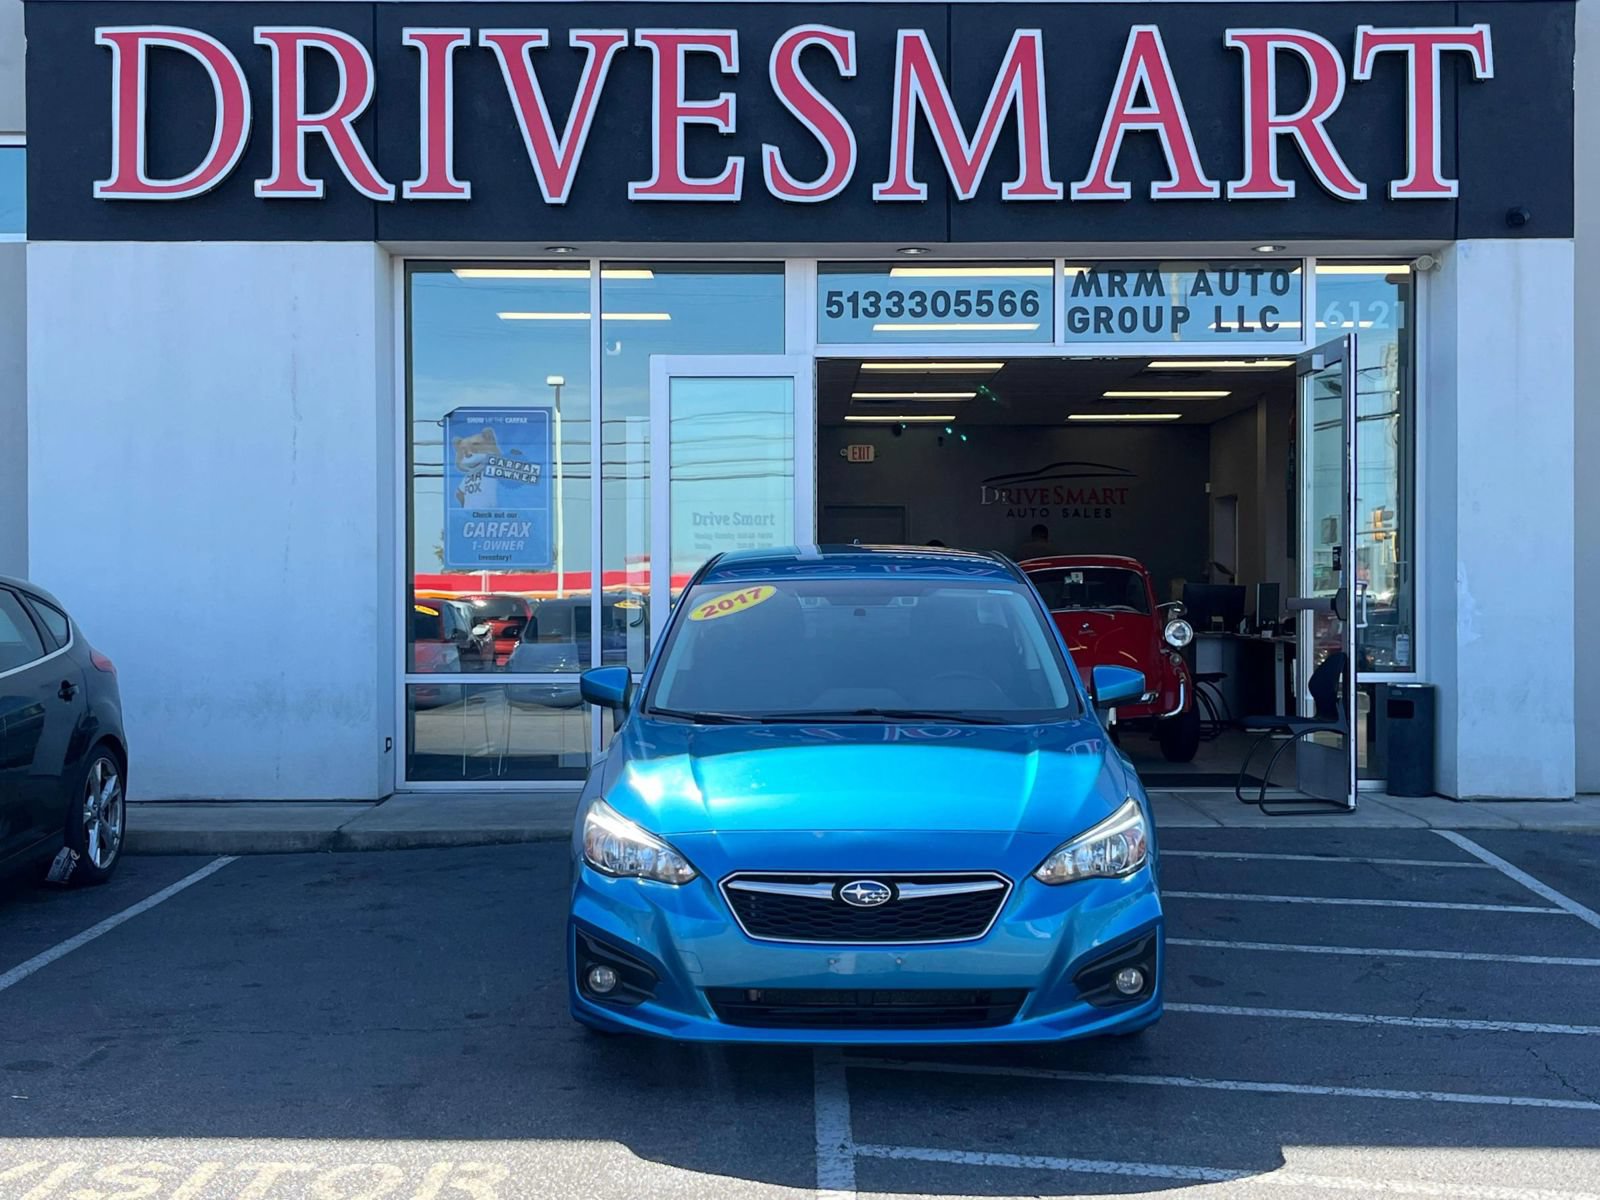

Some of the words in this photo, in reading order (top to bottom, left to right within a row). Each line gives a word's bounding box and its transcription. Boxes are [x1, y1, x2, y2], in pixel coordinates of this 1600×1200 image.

[93, 24, 1494, 205] DRIVESMART
[1070, 270, 1165, 298] MRM
[1190, 268, 1290, 297] AUTO
[826, 289, 1040, 319] 5133305566
[1067, 305, 1190, 334] GROUP
[1214, 305, 1280, 333] LLC
[1322, 300, 1405, 329] 6121
[852, 446, 870, 460] EXIT
[489, 457, 540, 475] CARFAX
[472, 511, 492, 519] Check
[692, 511, 730, 526] Drive
[732, 511, 775, 526] Smart
[1006, 508, 1050, 519] AUTO
[1062, 508, 1113, 519] SALES
[463, 522, 532, 538] CARFAX
[472, 540, 525, 551] 1-OWNER
[701, 588, 762, 618] 2017
